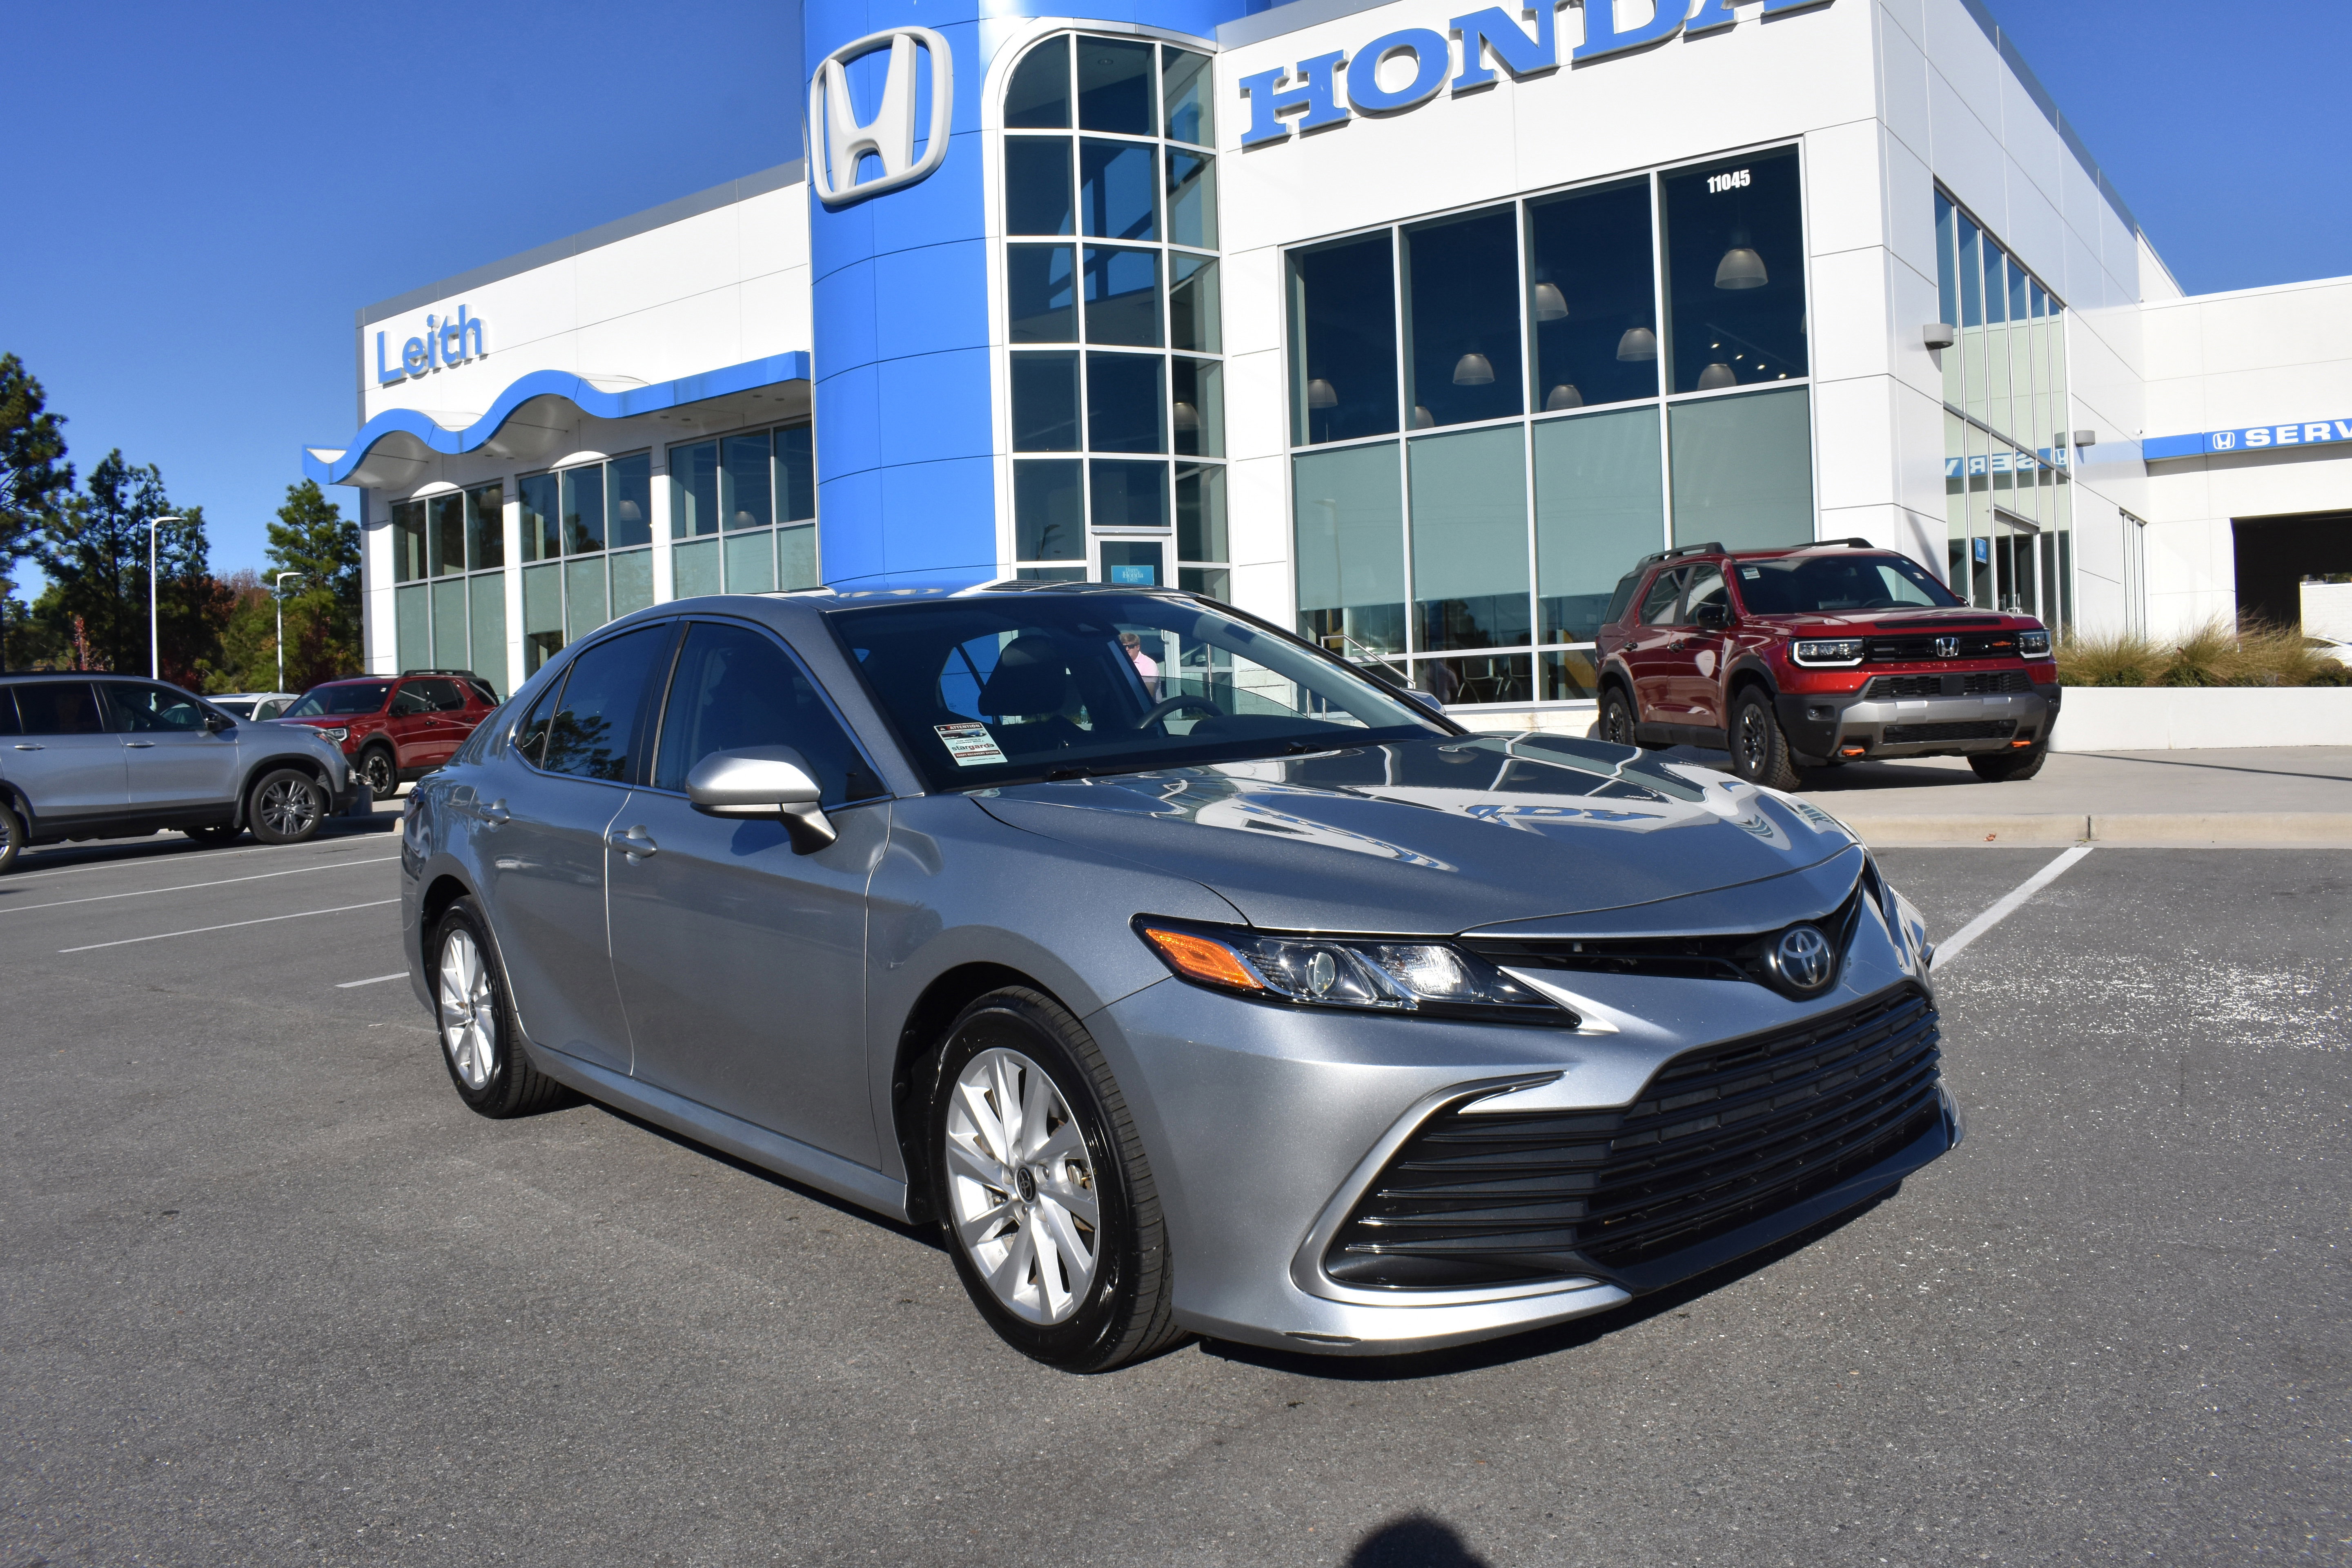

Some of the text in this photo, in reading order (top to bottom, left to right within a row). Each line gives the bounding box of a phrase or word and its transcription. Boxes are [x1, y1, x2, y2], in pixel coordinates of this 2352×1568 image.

[1239, 0, 1833, 145] HOND
[1707, 169, 1751, 193] 11045
[377, 304, 486, 384] Leith
